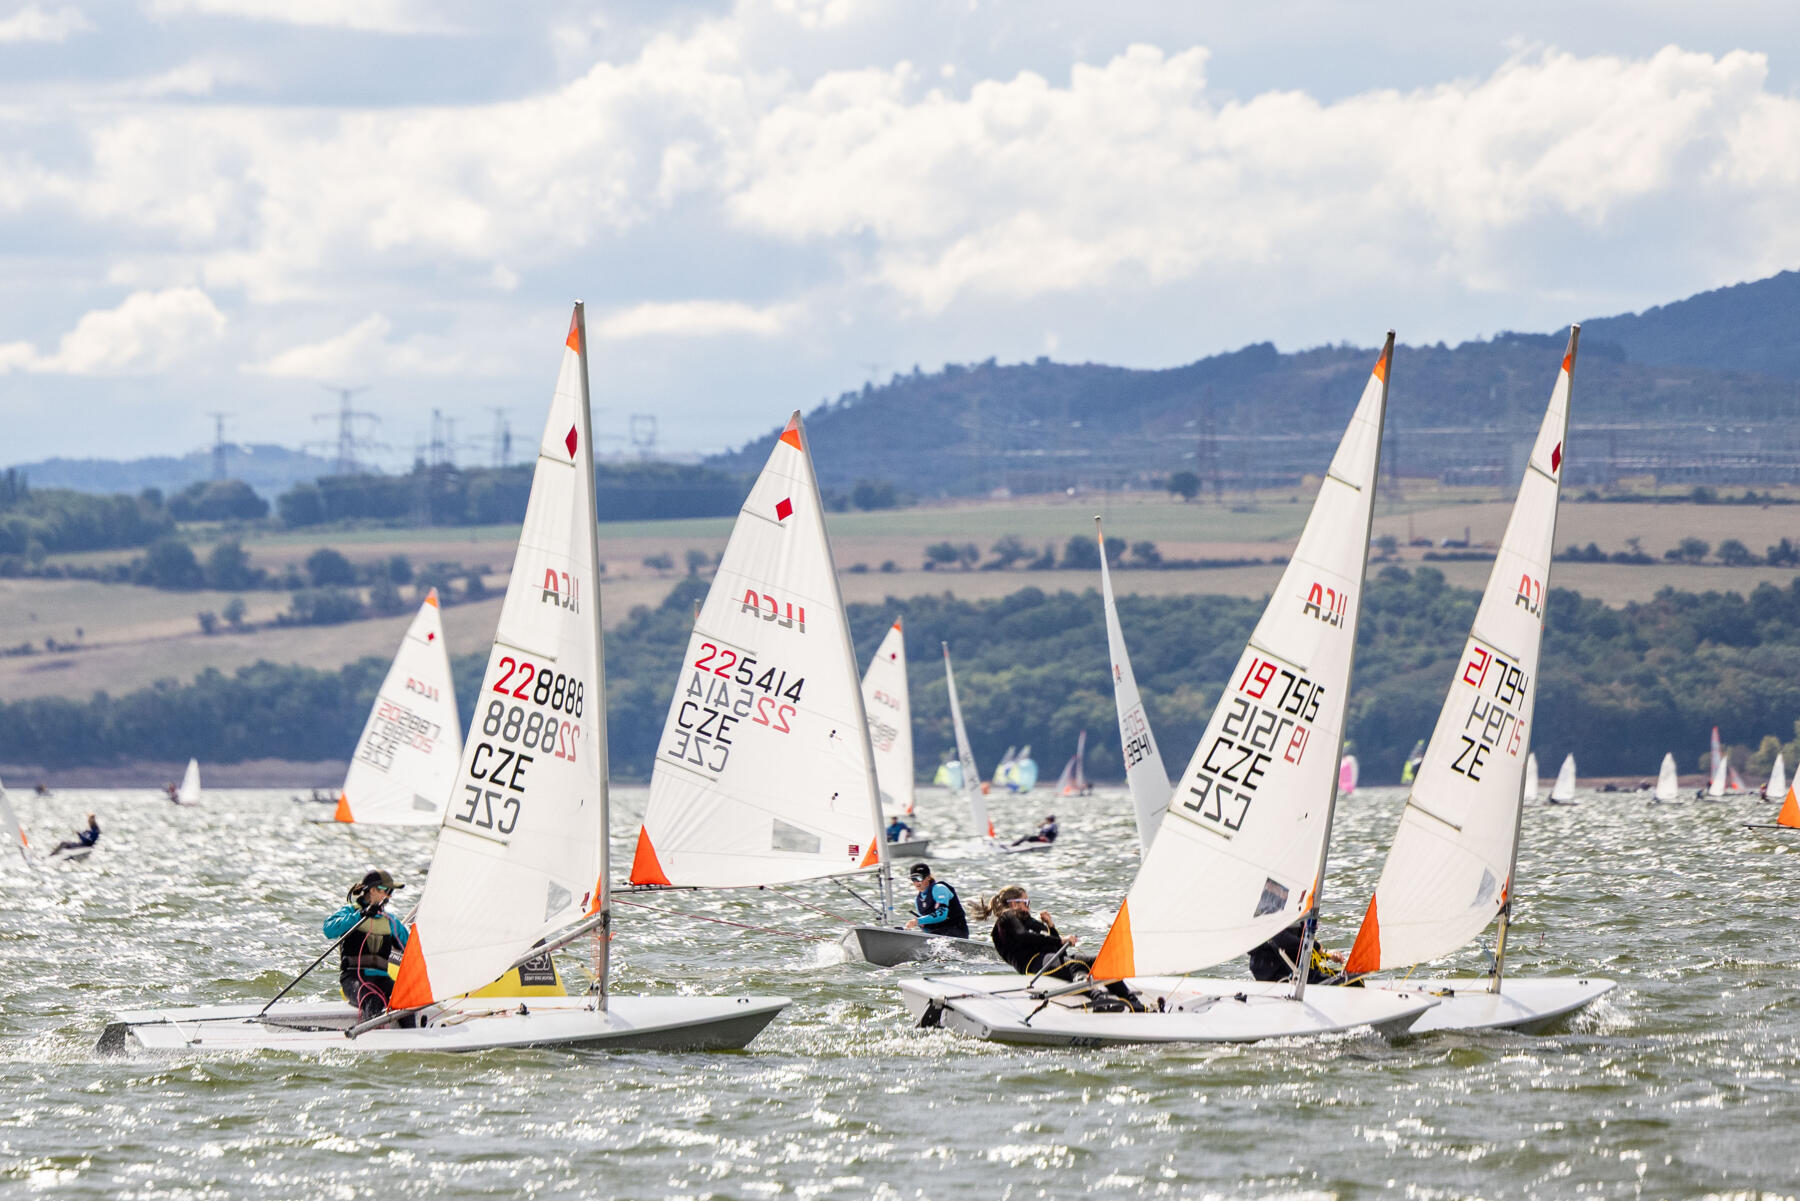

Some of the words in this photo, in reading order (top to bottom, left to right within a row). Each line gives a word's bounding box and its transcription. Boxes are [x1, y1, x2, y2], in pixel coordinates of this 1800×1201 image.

[493, 656, 584, 718] 228888
[695, 642, 805, 703] 225414
[1239, 657, 1325, 723] 197515
[678, 701, 739, 745] CZE
[470, 743, 534, 793] CZE
[1202, 736, 1272, 790] CZE
[1451, 734, 1490, 782] ZE
